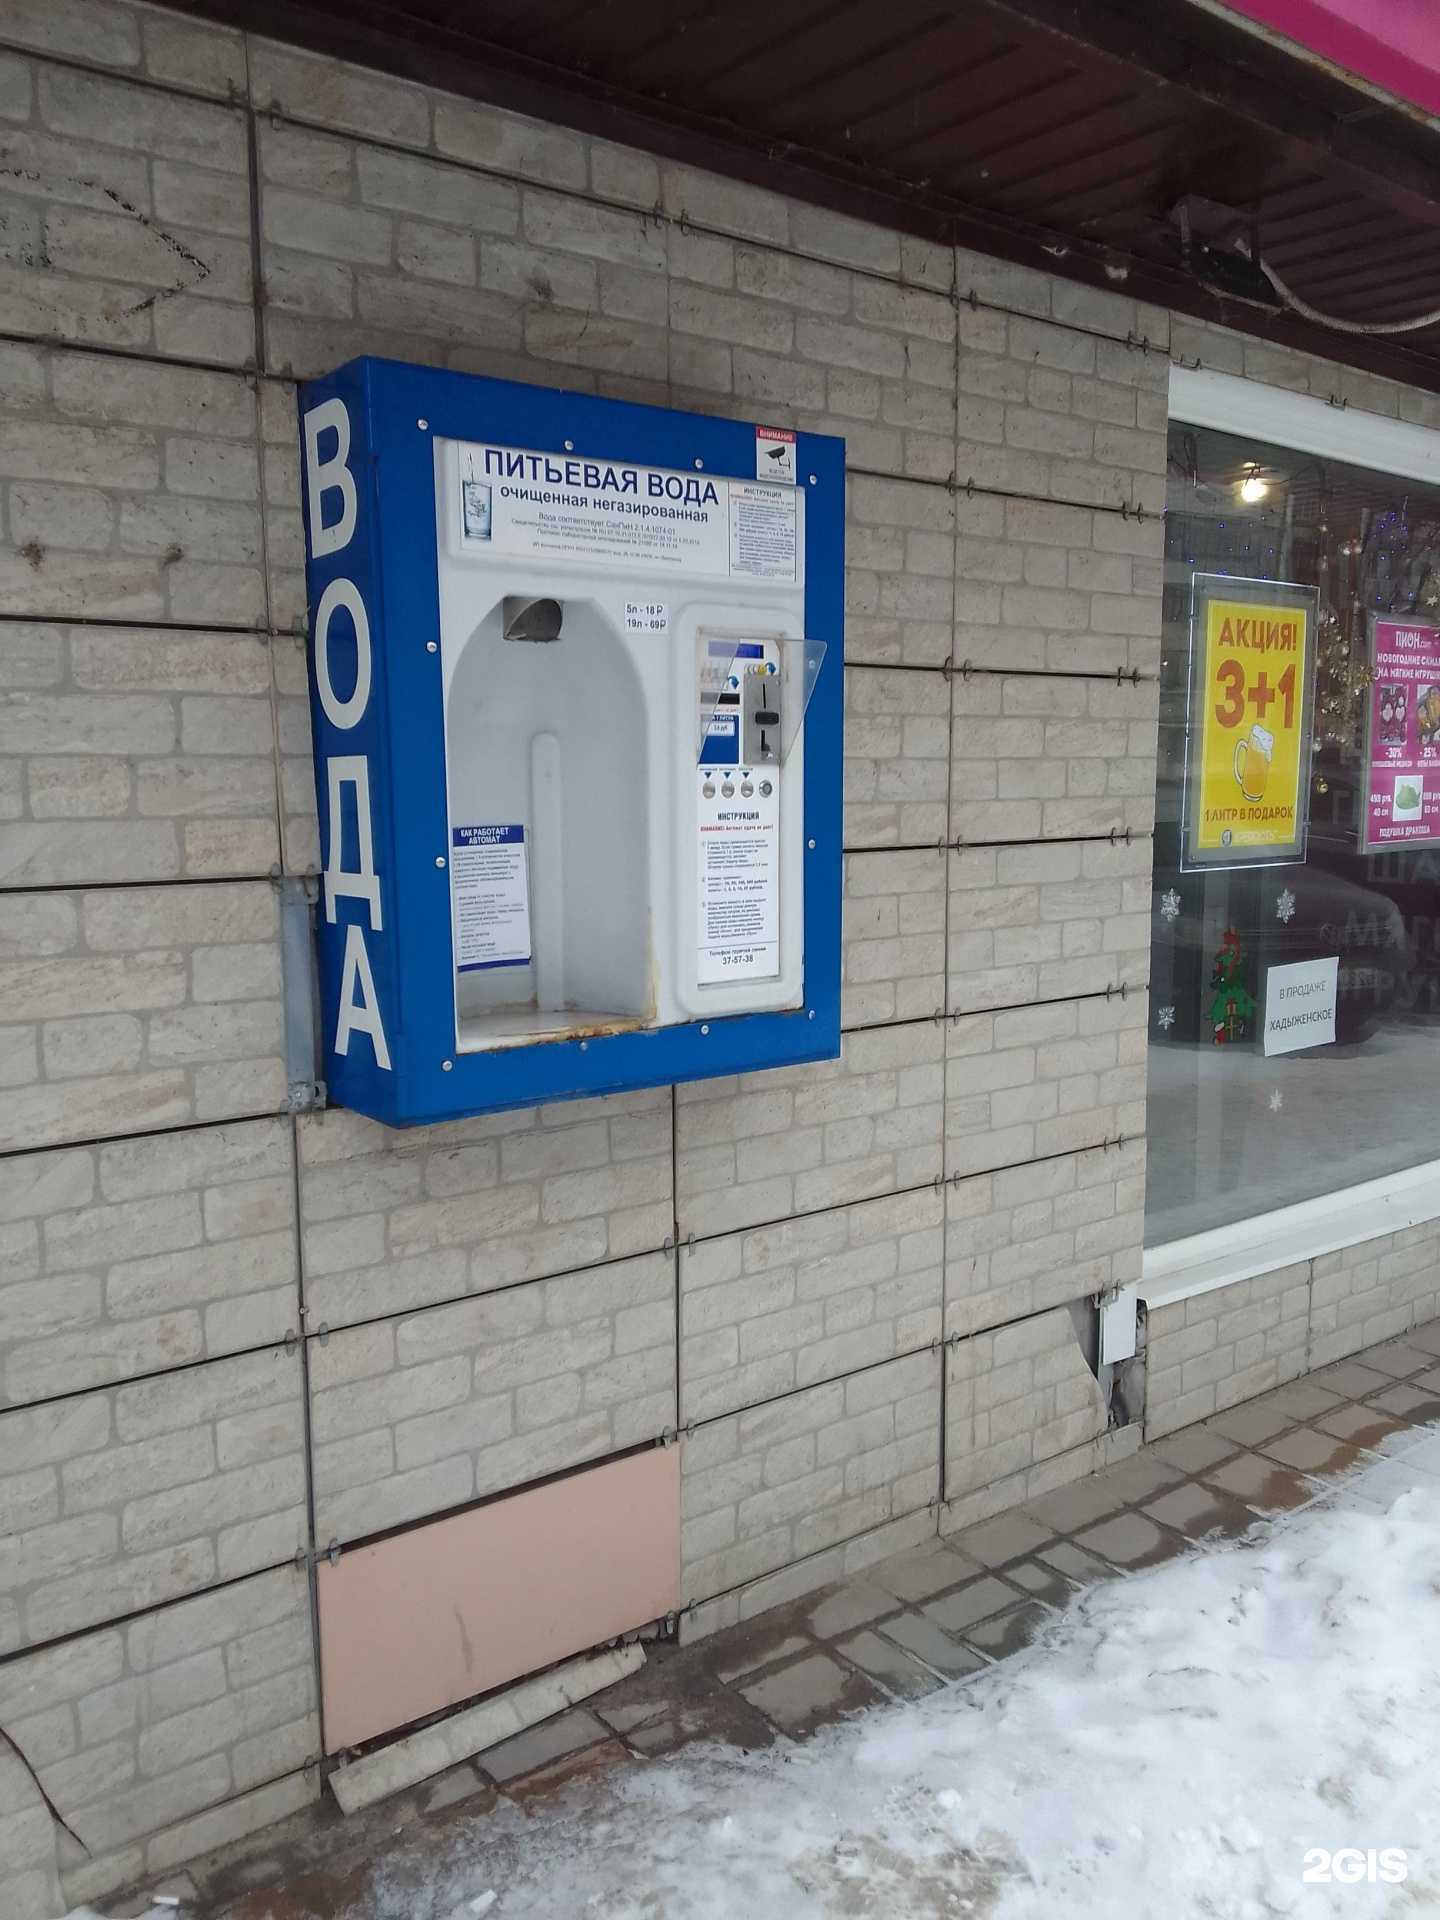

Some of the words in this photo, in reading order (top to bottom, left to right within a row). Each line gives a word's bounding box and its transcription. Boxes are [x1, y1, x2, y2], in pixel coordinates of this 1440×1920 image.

[484, 448, 638, 494] ПИТЬЕВАЯ
[647, 474, 720, 507] ВОДА
[499, 486, 589, 510] очищенная
[592, 499, 709, 524] негазированная
[646, 605, 655, 615] 18
[1218, 617, 1298, 655] АКЦИЯ!
[1215, 659, 1297, 729] 3+1
[303, 398, 392, 1070] ВОДА
[717, 811, 760, 822] ИНСТРУКЦИЯ
[1212, 807, 1238, 823] ЛИТР
[1239, 807, 1246, 820] В
[1247, 805, 1294, 822] ПОДАРОК
[460, 828, 473, 838] КАК
[473, 826, 509, 837] РАБОТАЕТ
[468, 835, 501, 845] АВТОМАТ
[722, 954, 754, 965] 37-57-38
[1279, 988, 1285, 1000] В
[1286, 980, 1328, 998] ПРОДАЖЕ
[1269, 1008, 1334, 1032] ХАДЫЖЕНСКОЕ
